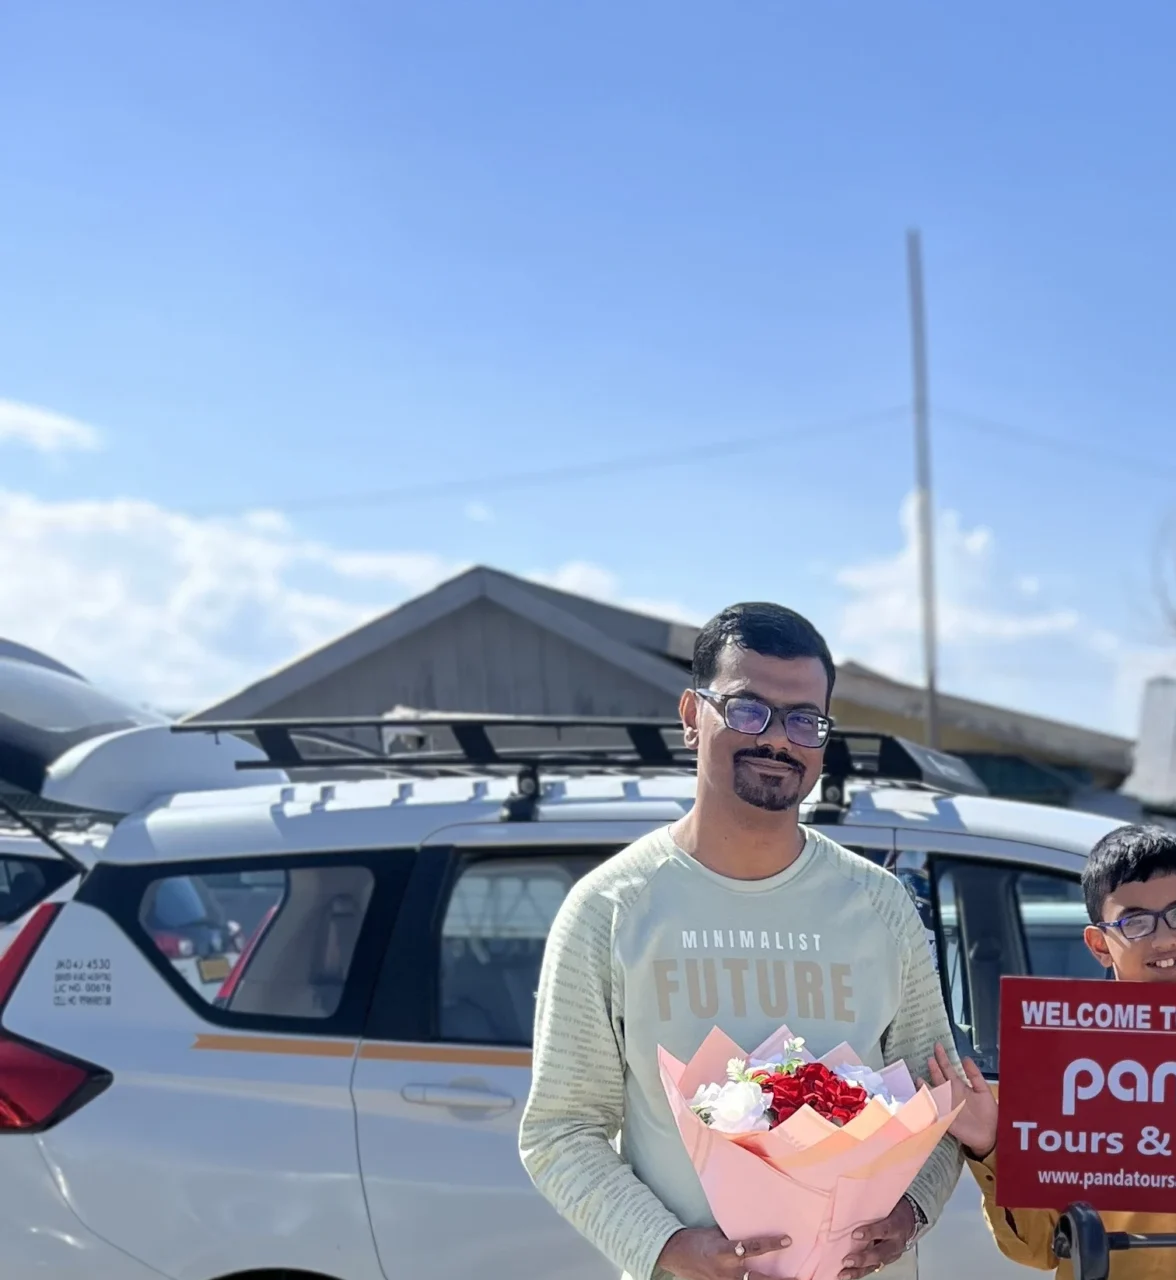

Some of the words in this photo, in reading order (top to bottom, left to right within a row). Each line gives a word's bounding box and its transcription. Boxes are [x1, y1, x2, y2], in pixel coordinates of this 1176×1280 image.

[681, 929, 822, 951] MINIMALIST
[652, 957, 856, 1023] FUTURE
[1021, 1001, 1151, 1029] WELCOME
[1012, 1121, 1124, 1155] Tours
[1136, 1125, 1172, 1157] &
